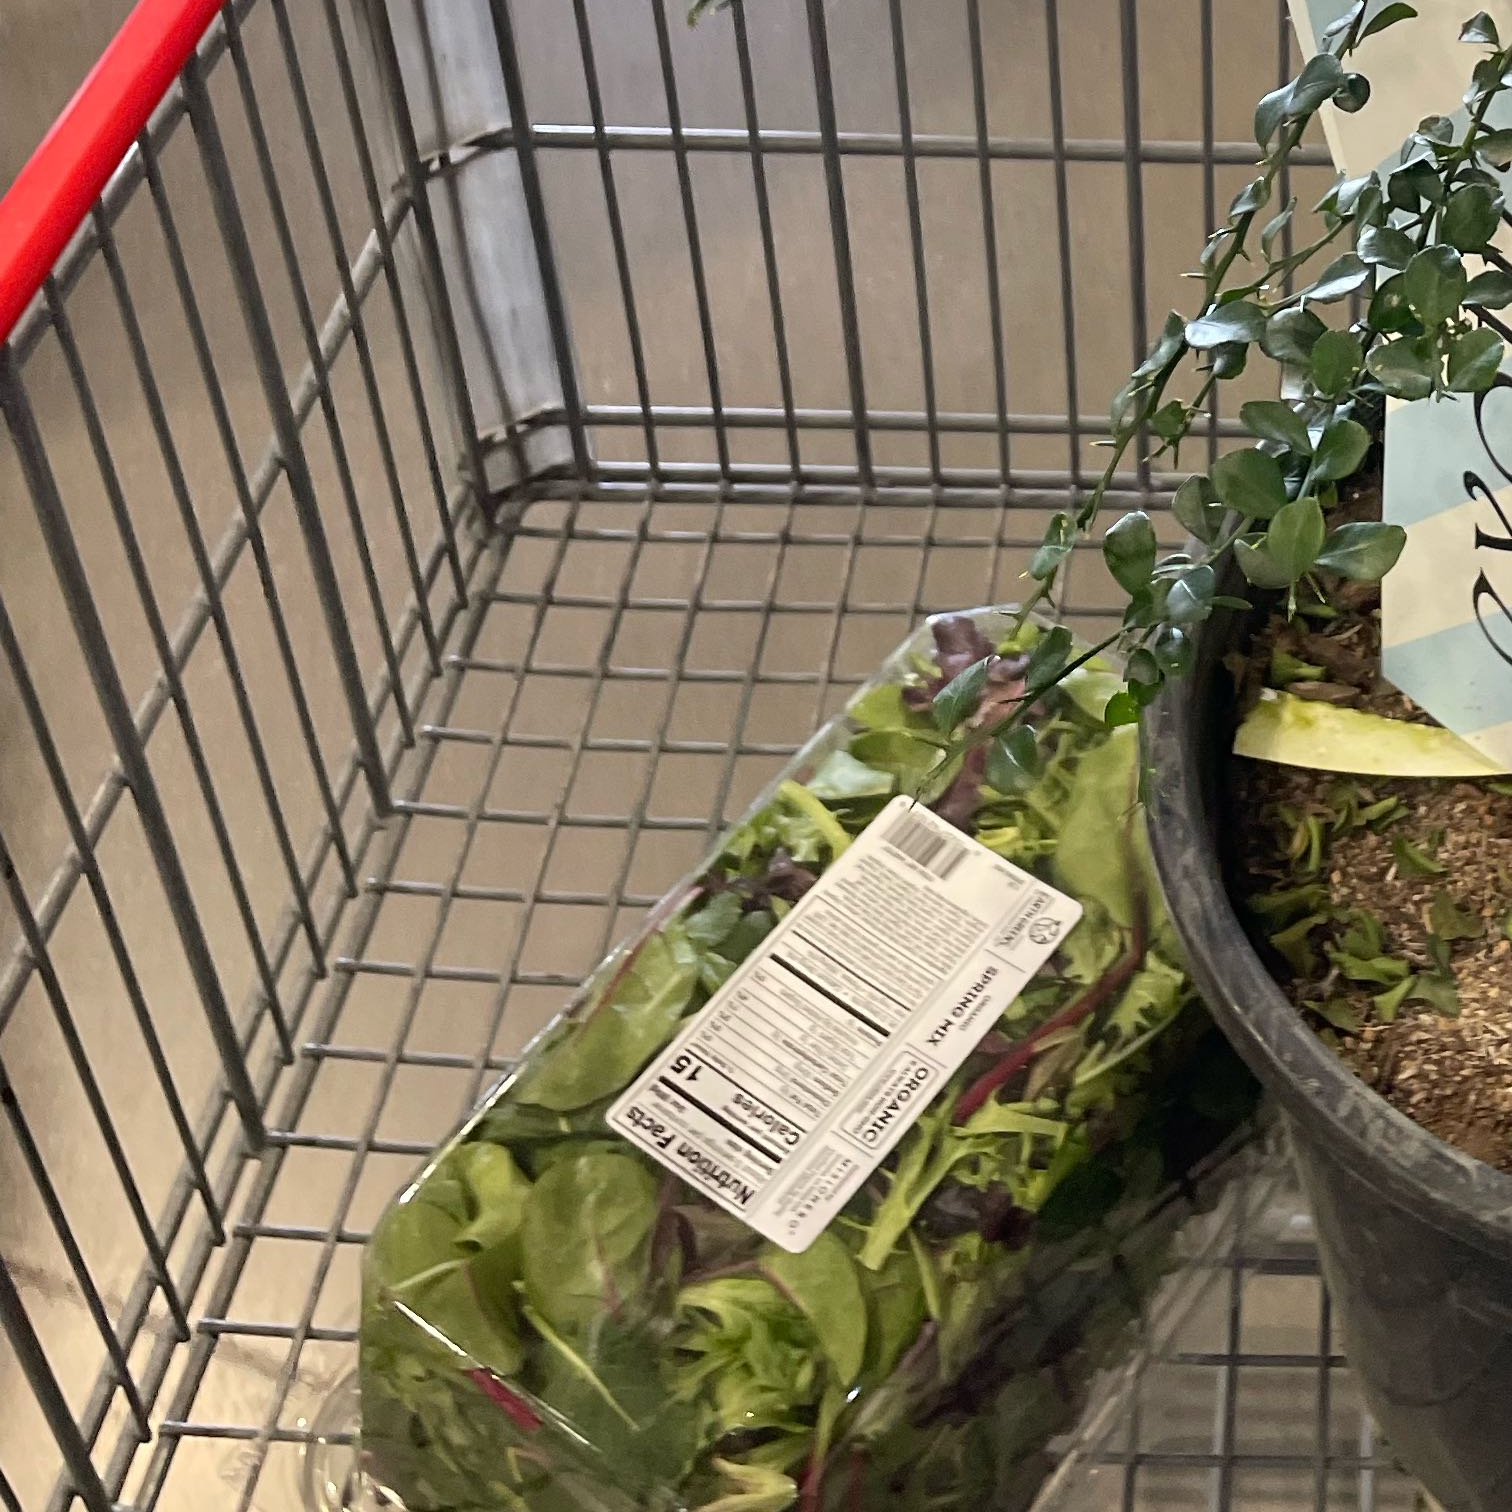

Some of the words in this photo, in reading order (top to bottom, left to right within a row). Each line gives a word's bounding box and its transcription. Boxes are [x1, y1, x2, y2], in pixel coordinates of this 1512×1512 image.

[950, 965, 1000, 1019] SPRING
[928, 1018, 952, 1047] MIX
[671, 1055, 702, 1081] 15
[626, 1106, 676, 1150] Facts
[733, 1093, 800, 1145] Calories
[863, 1066, 929, 1143] ORGANIC
[676, 1141, 755, 1205] Nutrition
